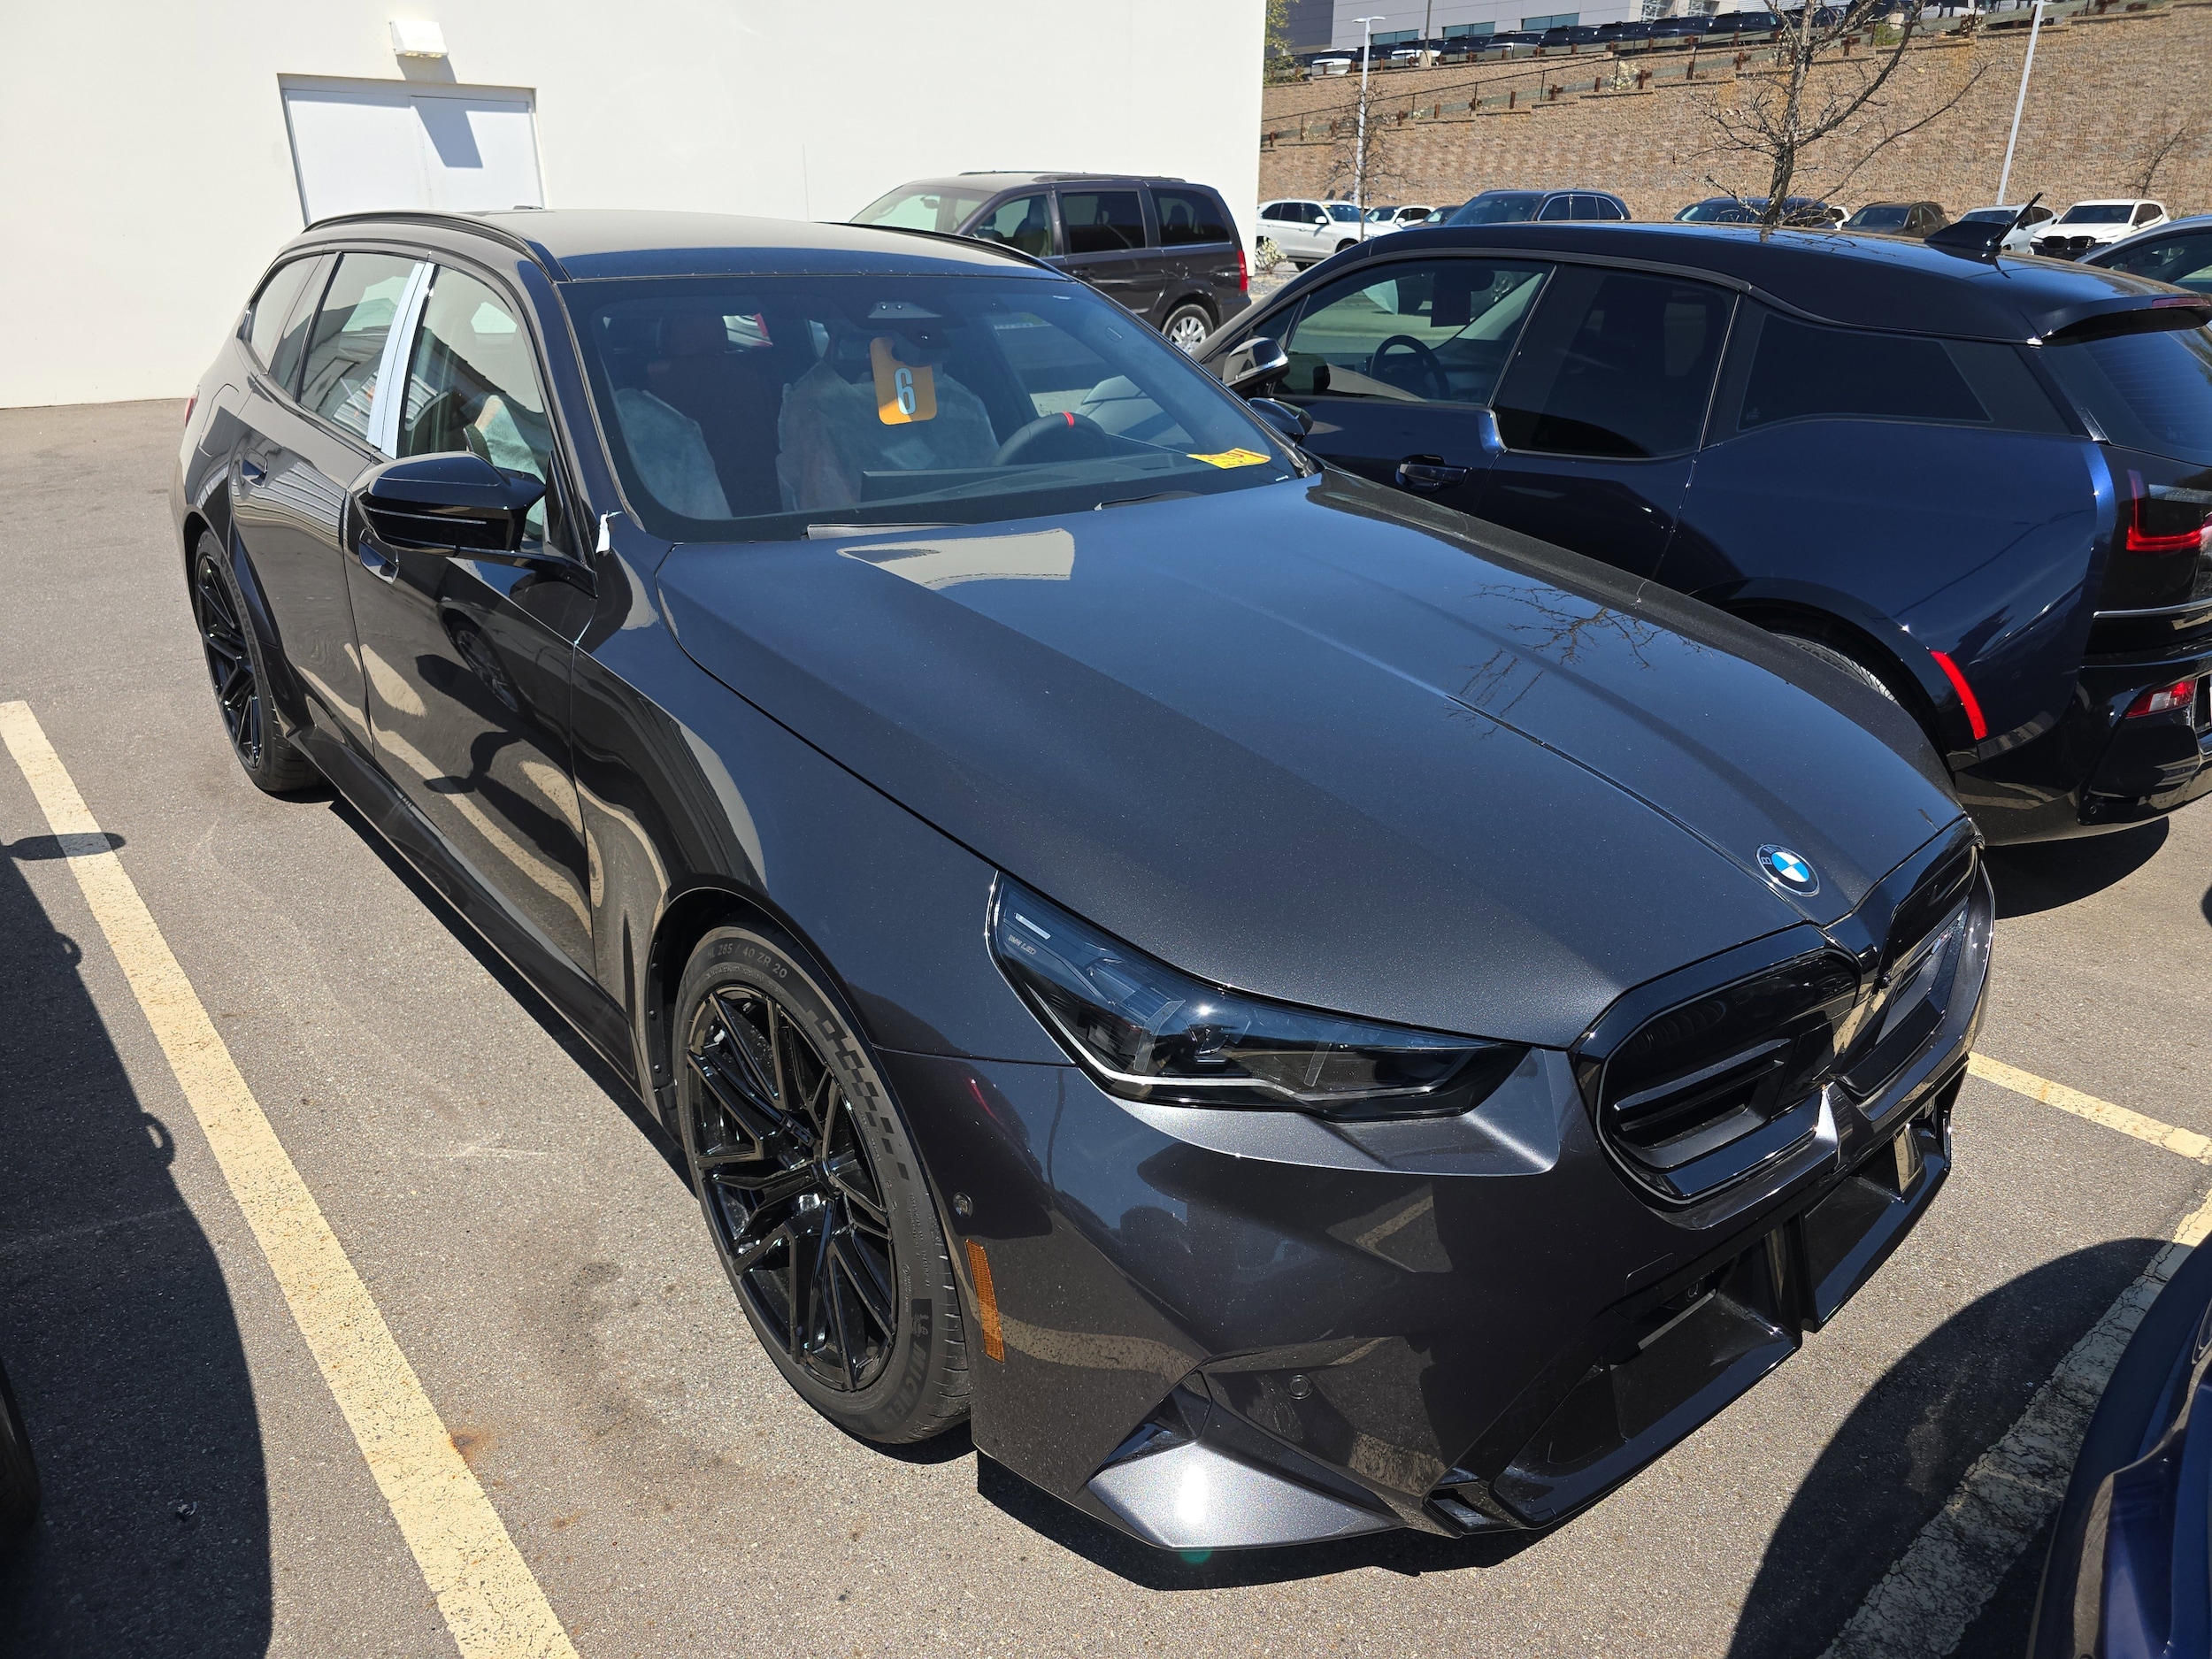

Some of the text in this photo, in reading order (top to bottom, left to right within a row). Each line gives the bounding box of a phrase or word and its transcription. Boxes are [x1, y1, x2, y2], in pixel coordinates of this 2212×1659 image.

[895, 366, 917, 415] 6
[718, 942, 733, 956] 285
[742, 946, 756, 958] 40
[757, 951, 772, 968] ZR
[772, 963, 788, 979] 20
[872, 1341, 926, 1432] MICHEL
